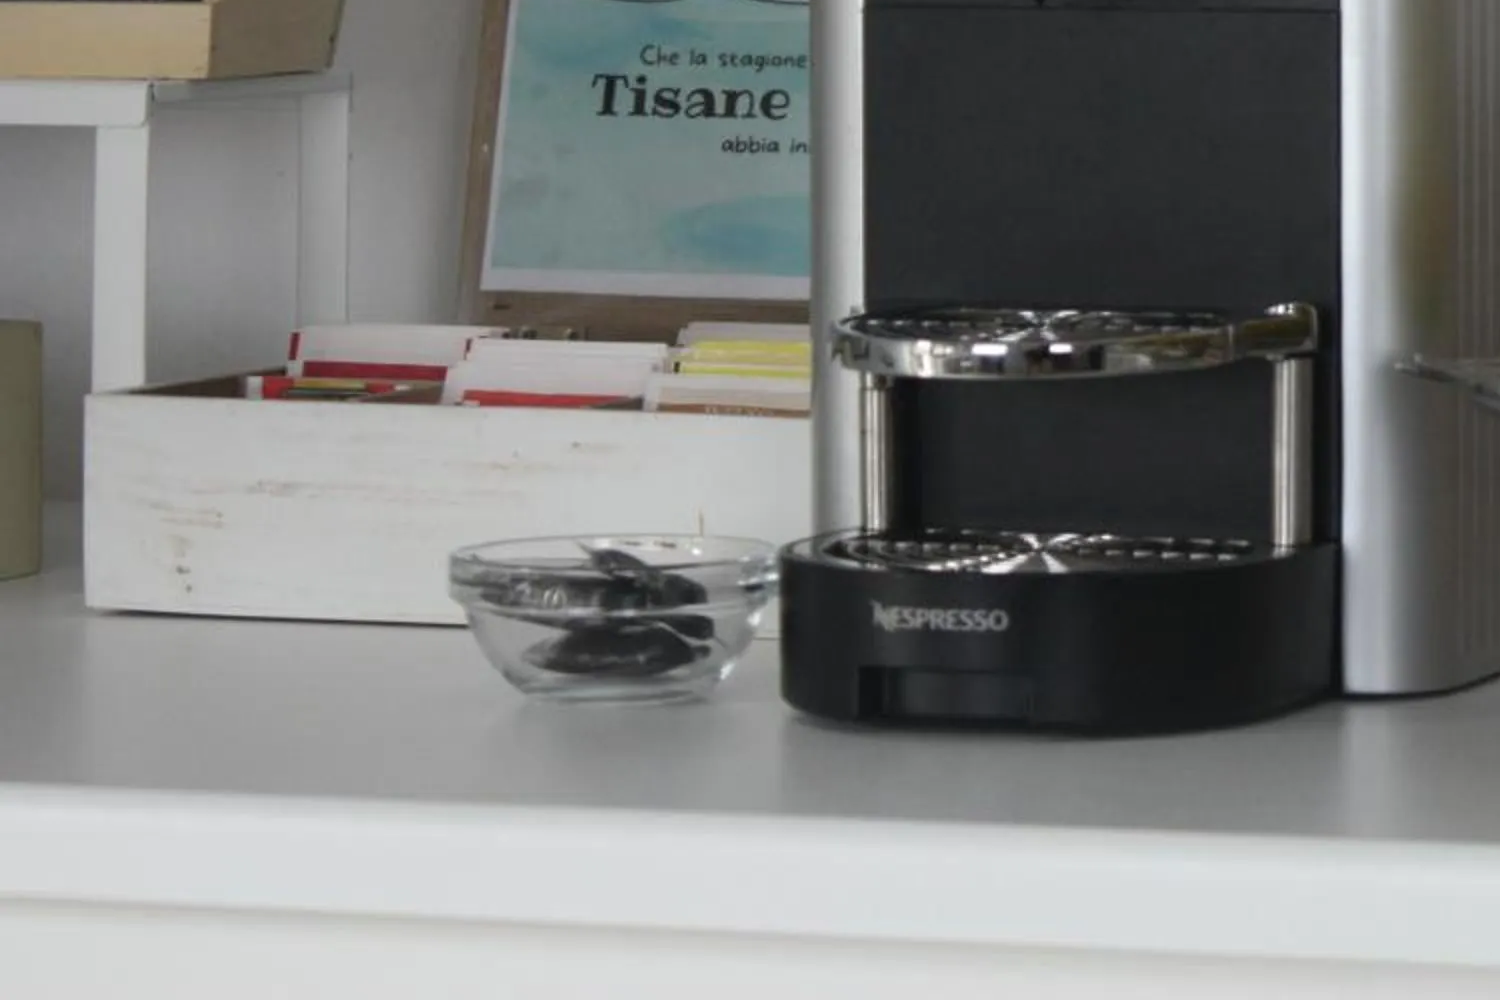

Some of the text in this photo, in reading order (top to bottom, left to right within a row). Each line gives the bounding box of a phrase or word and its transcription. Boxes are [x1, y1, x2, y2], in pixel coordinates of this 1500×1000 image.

[639, 44, 809, 73] Che la stagione
[591, 72, 791, 121] Tisane
[720, 136, 811, 154] abbia in
[871, 599, 1009, 632] NESPRESSO
